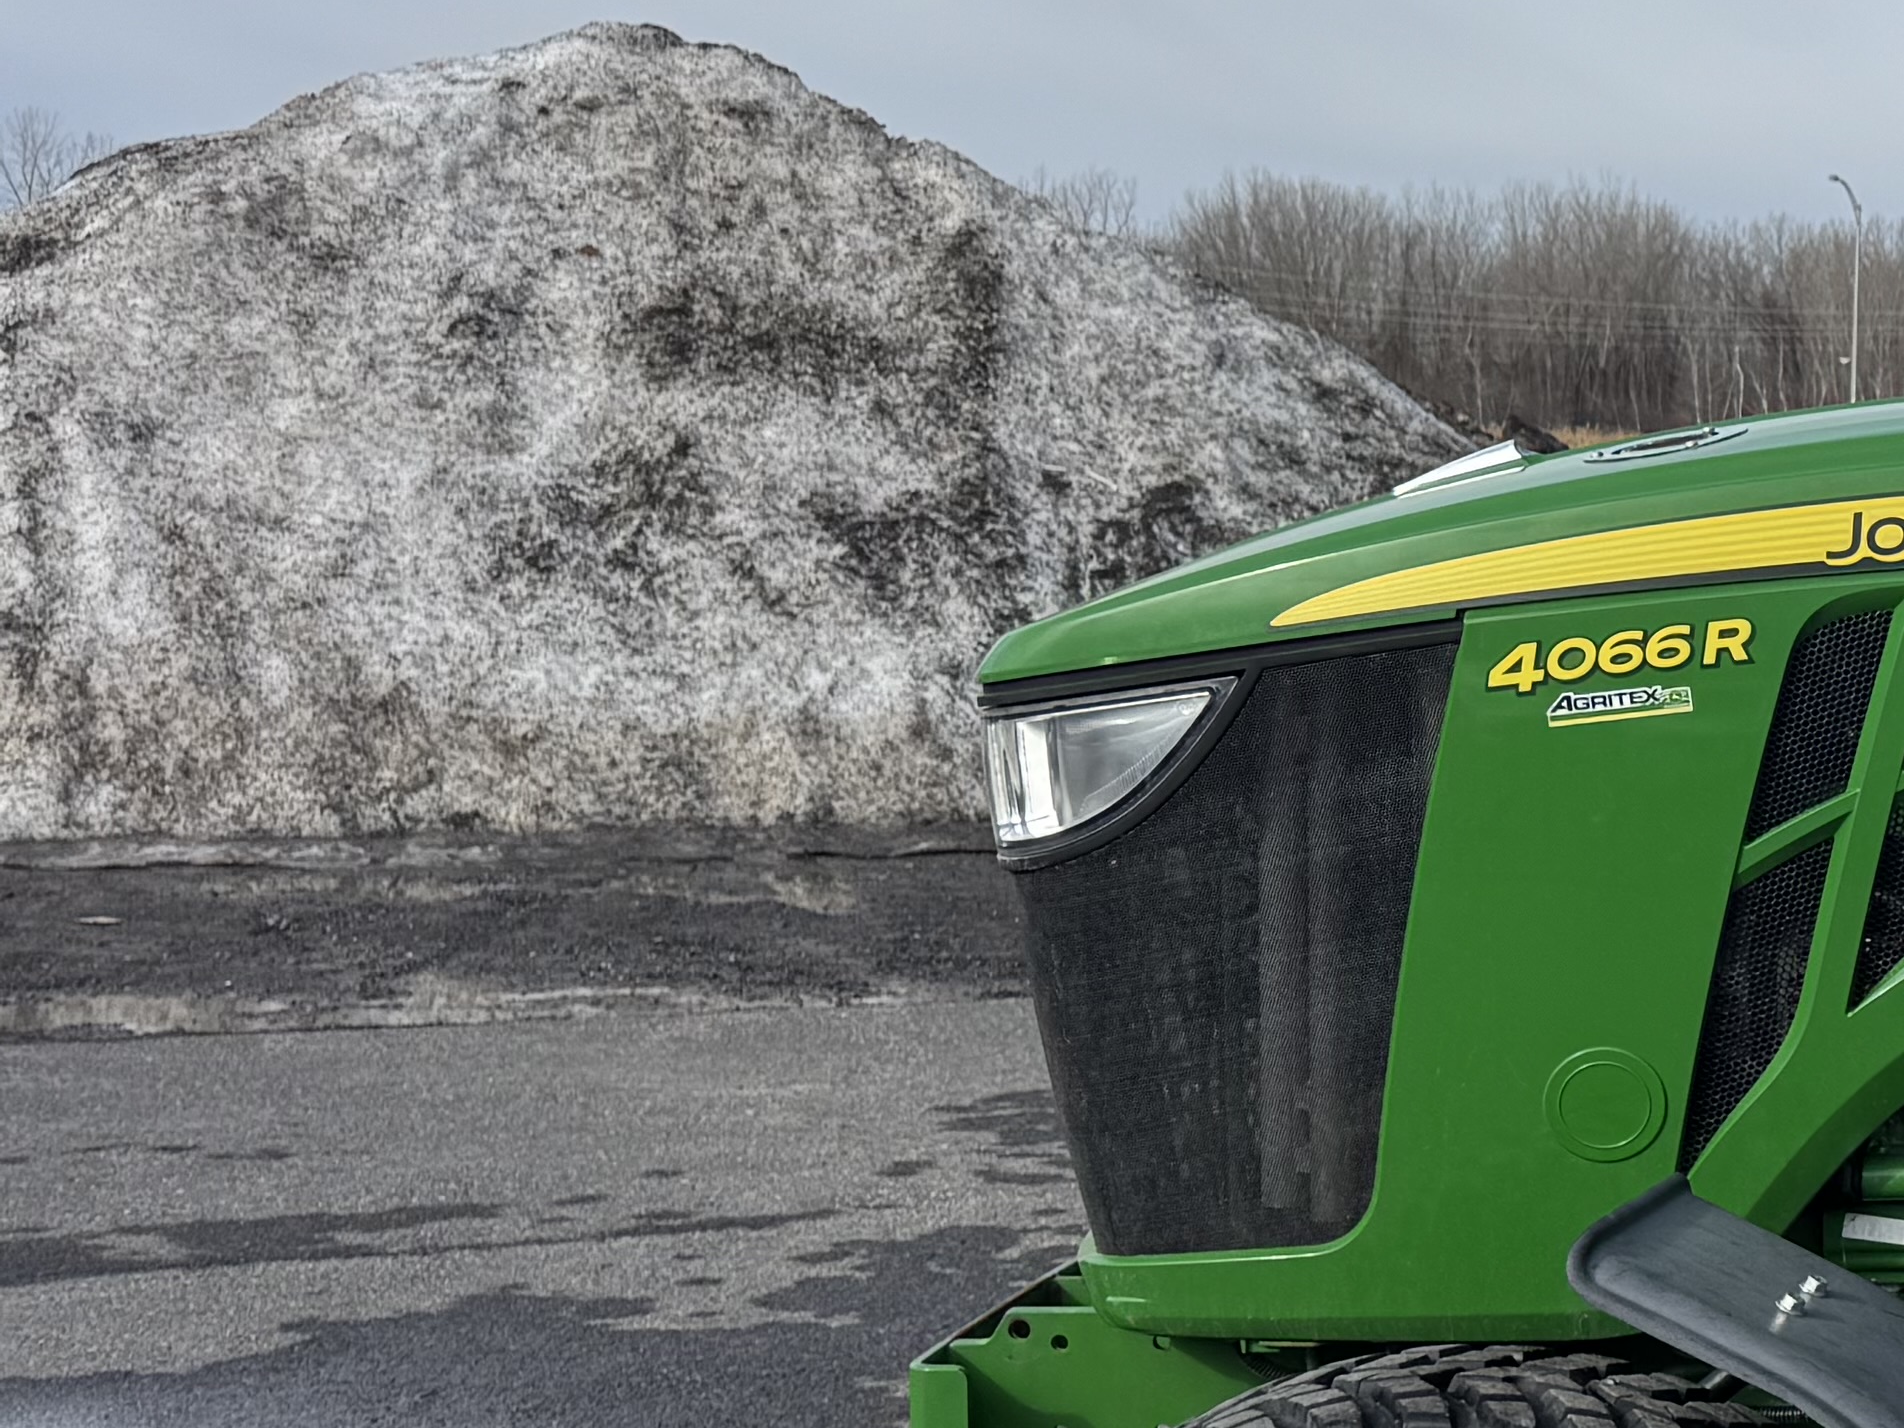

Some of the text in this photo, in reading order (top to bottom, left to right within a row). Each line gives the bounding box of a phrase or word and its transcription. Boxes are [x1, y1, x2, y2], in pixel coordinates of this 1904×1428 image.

[1485, 616, 1754, 694] 4066 R
[1549, 685, 1663, 714] AGRITEX
